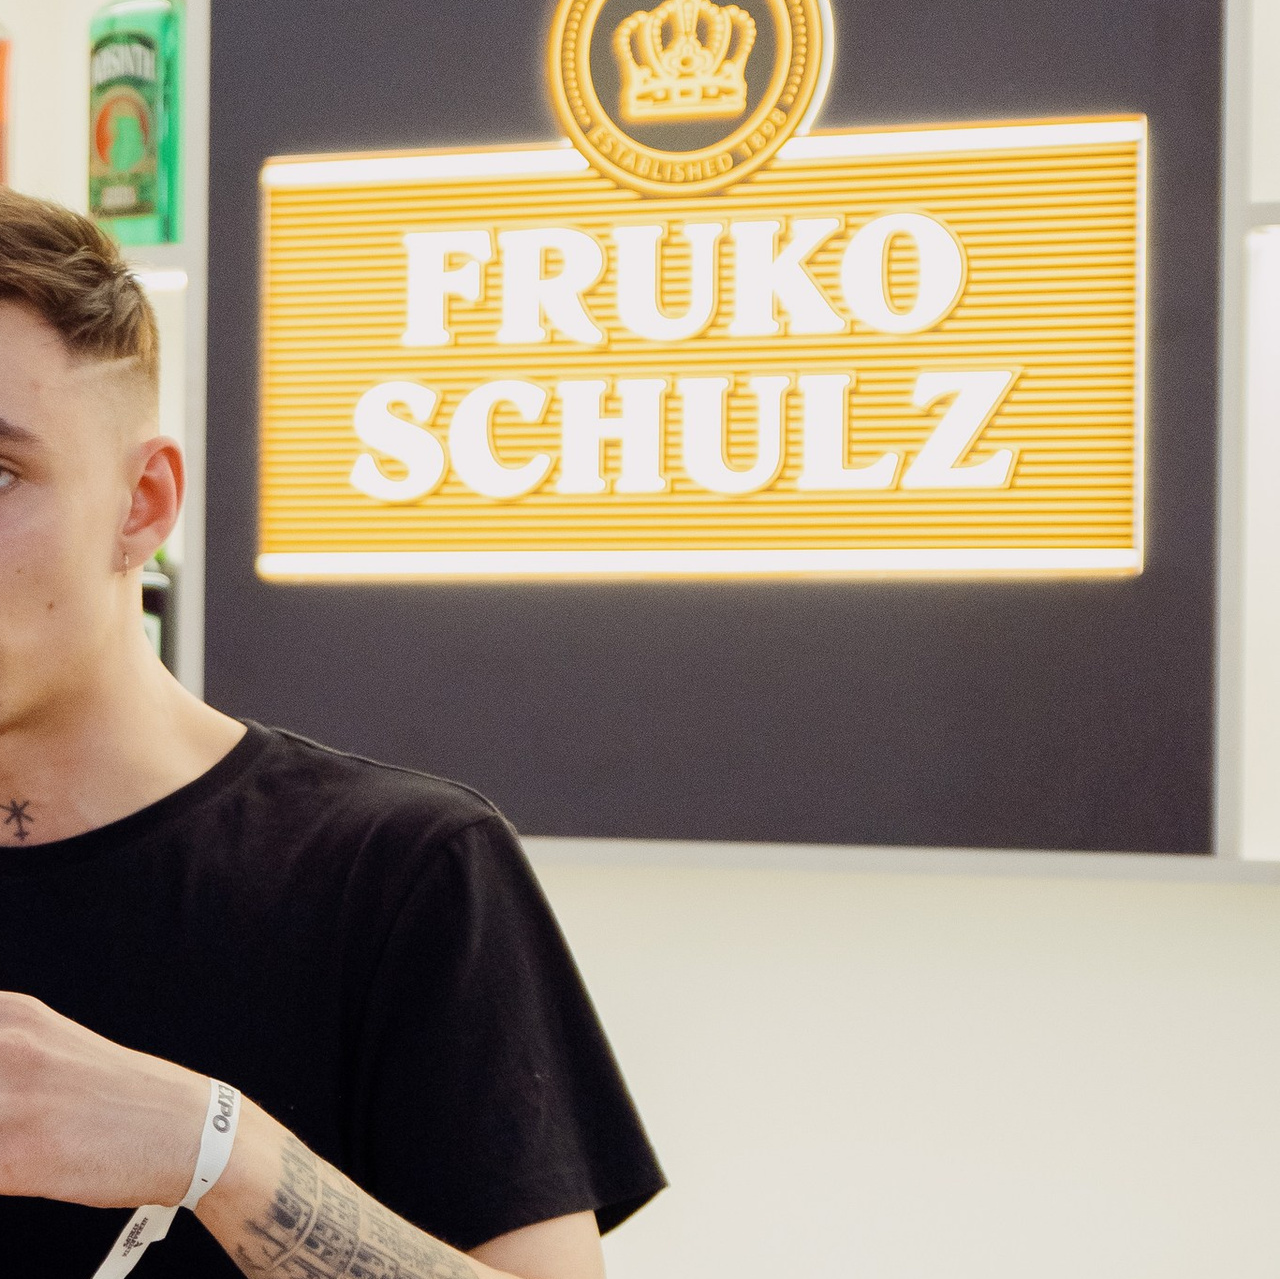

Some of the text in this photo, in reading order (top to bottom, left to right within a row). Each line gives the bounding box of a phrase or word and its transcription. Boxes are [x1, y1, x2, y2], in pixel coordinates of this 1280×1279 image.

[587, 106, 788, 182] ESTABLISHED 1898
[401, 212, 968, 348] FRUKO
[348, 368, 1022, 503] SCHULZ
[213, 1084, 235, 1133] EXPO
